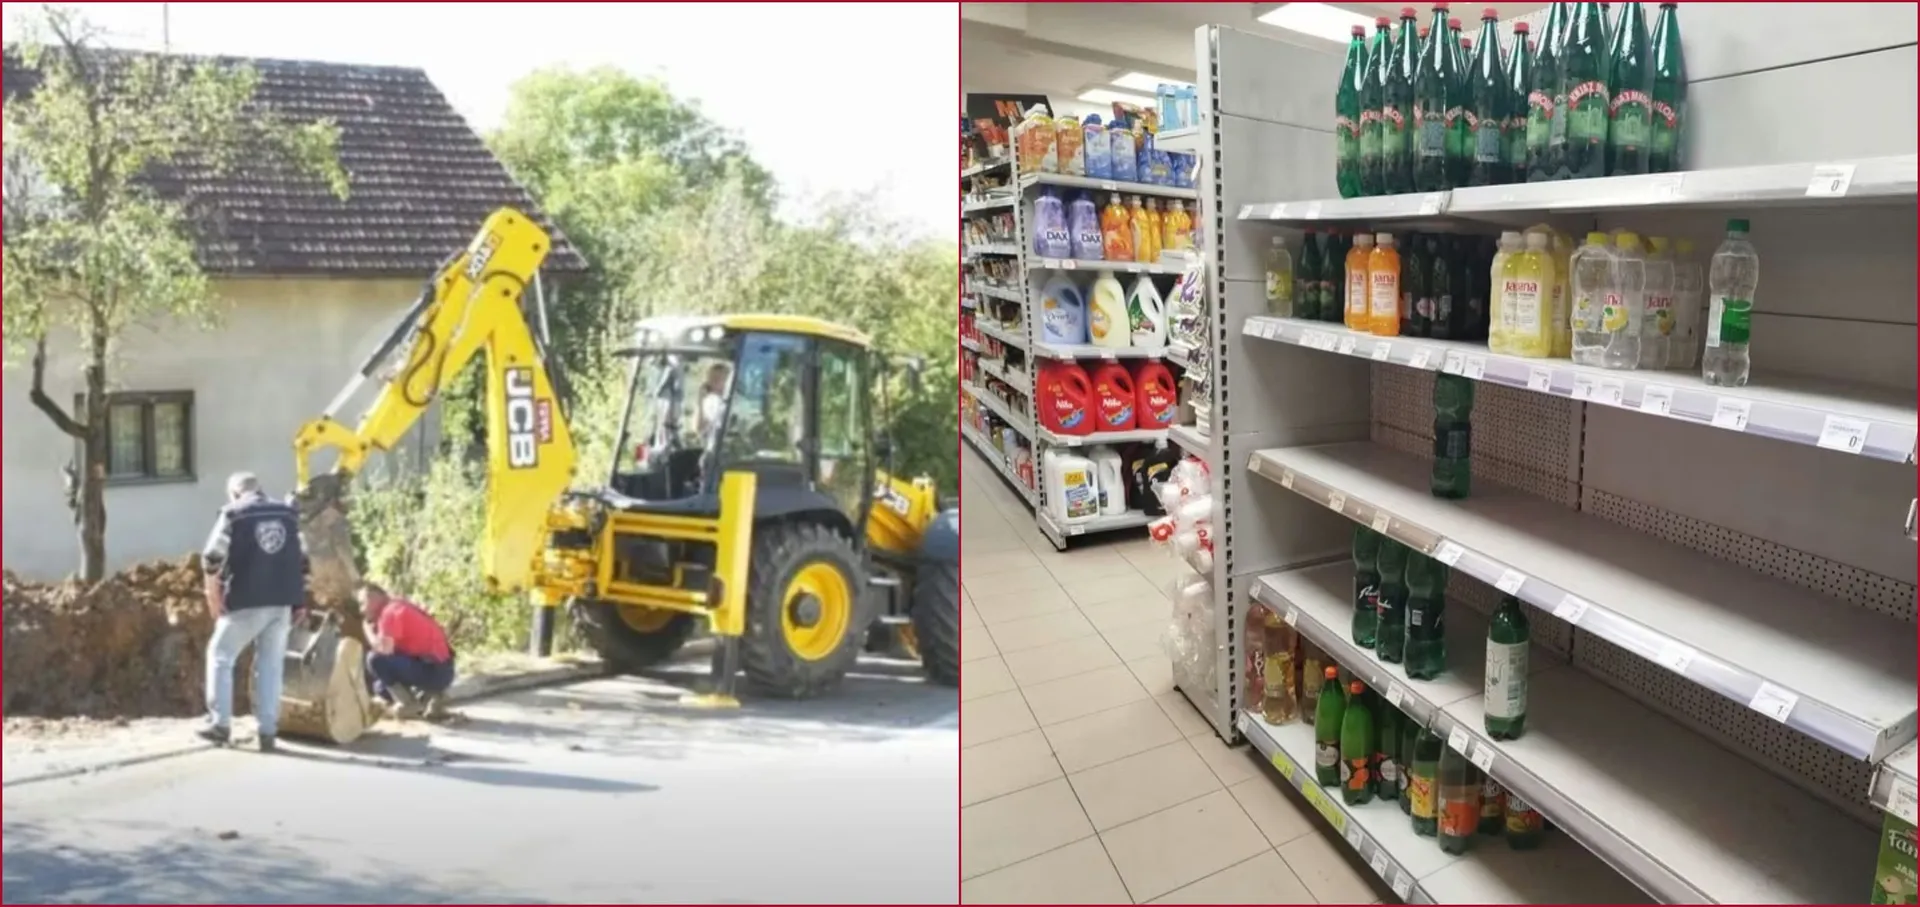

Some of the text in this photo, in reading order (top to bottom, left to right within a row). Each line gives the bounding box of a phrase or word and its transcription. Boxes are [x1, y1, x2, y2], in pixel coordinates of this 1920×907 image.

[1046, 231, 1069, 241] DAX
[1081, 233, 1102, 243] DAX
[1374, 272, 1396, 284] Jana
[506, 368, 537, 467] JCB
